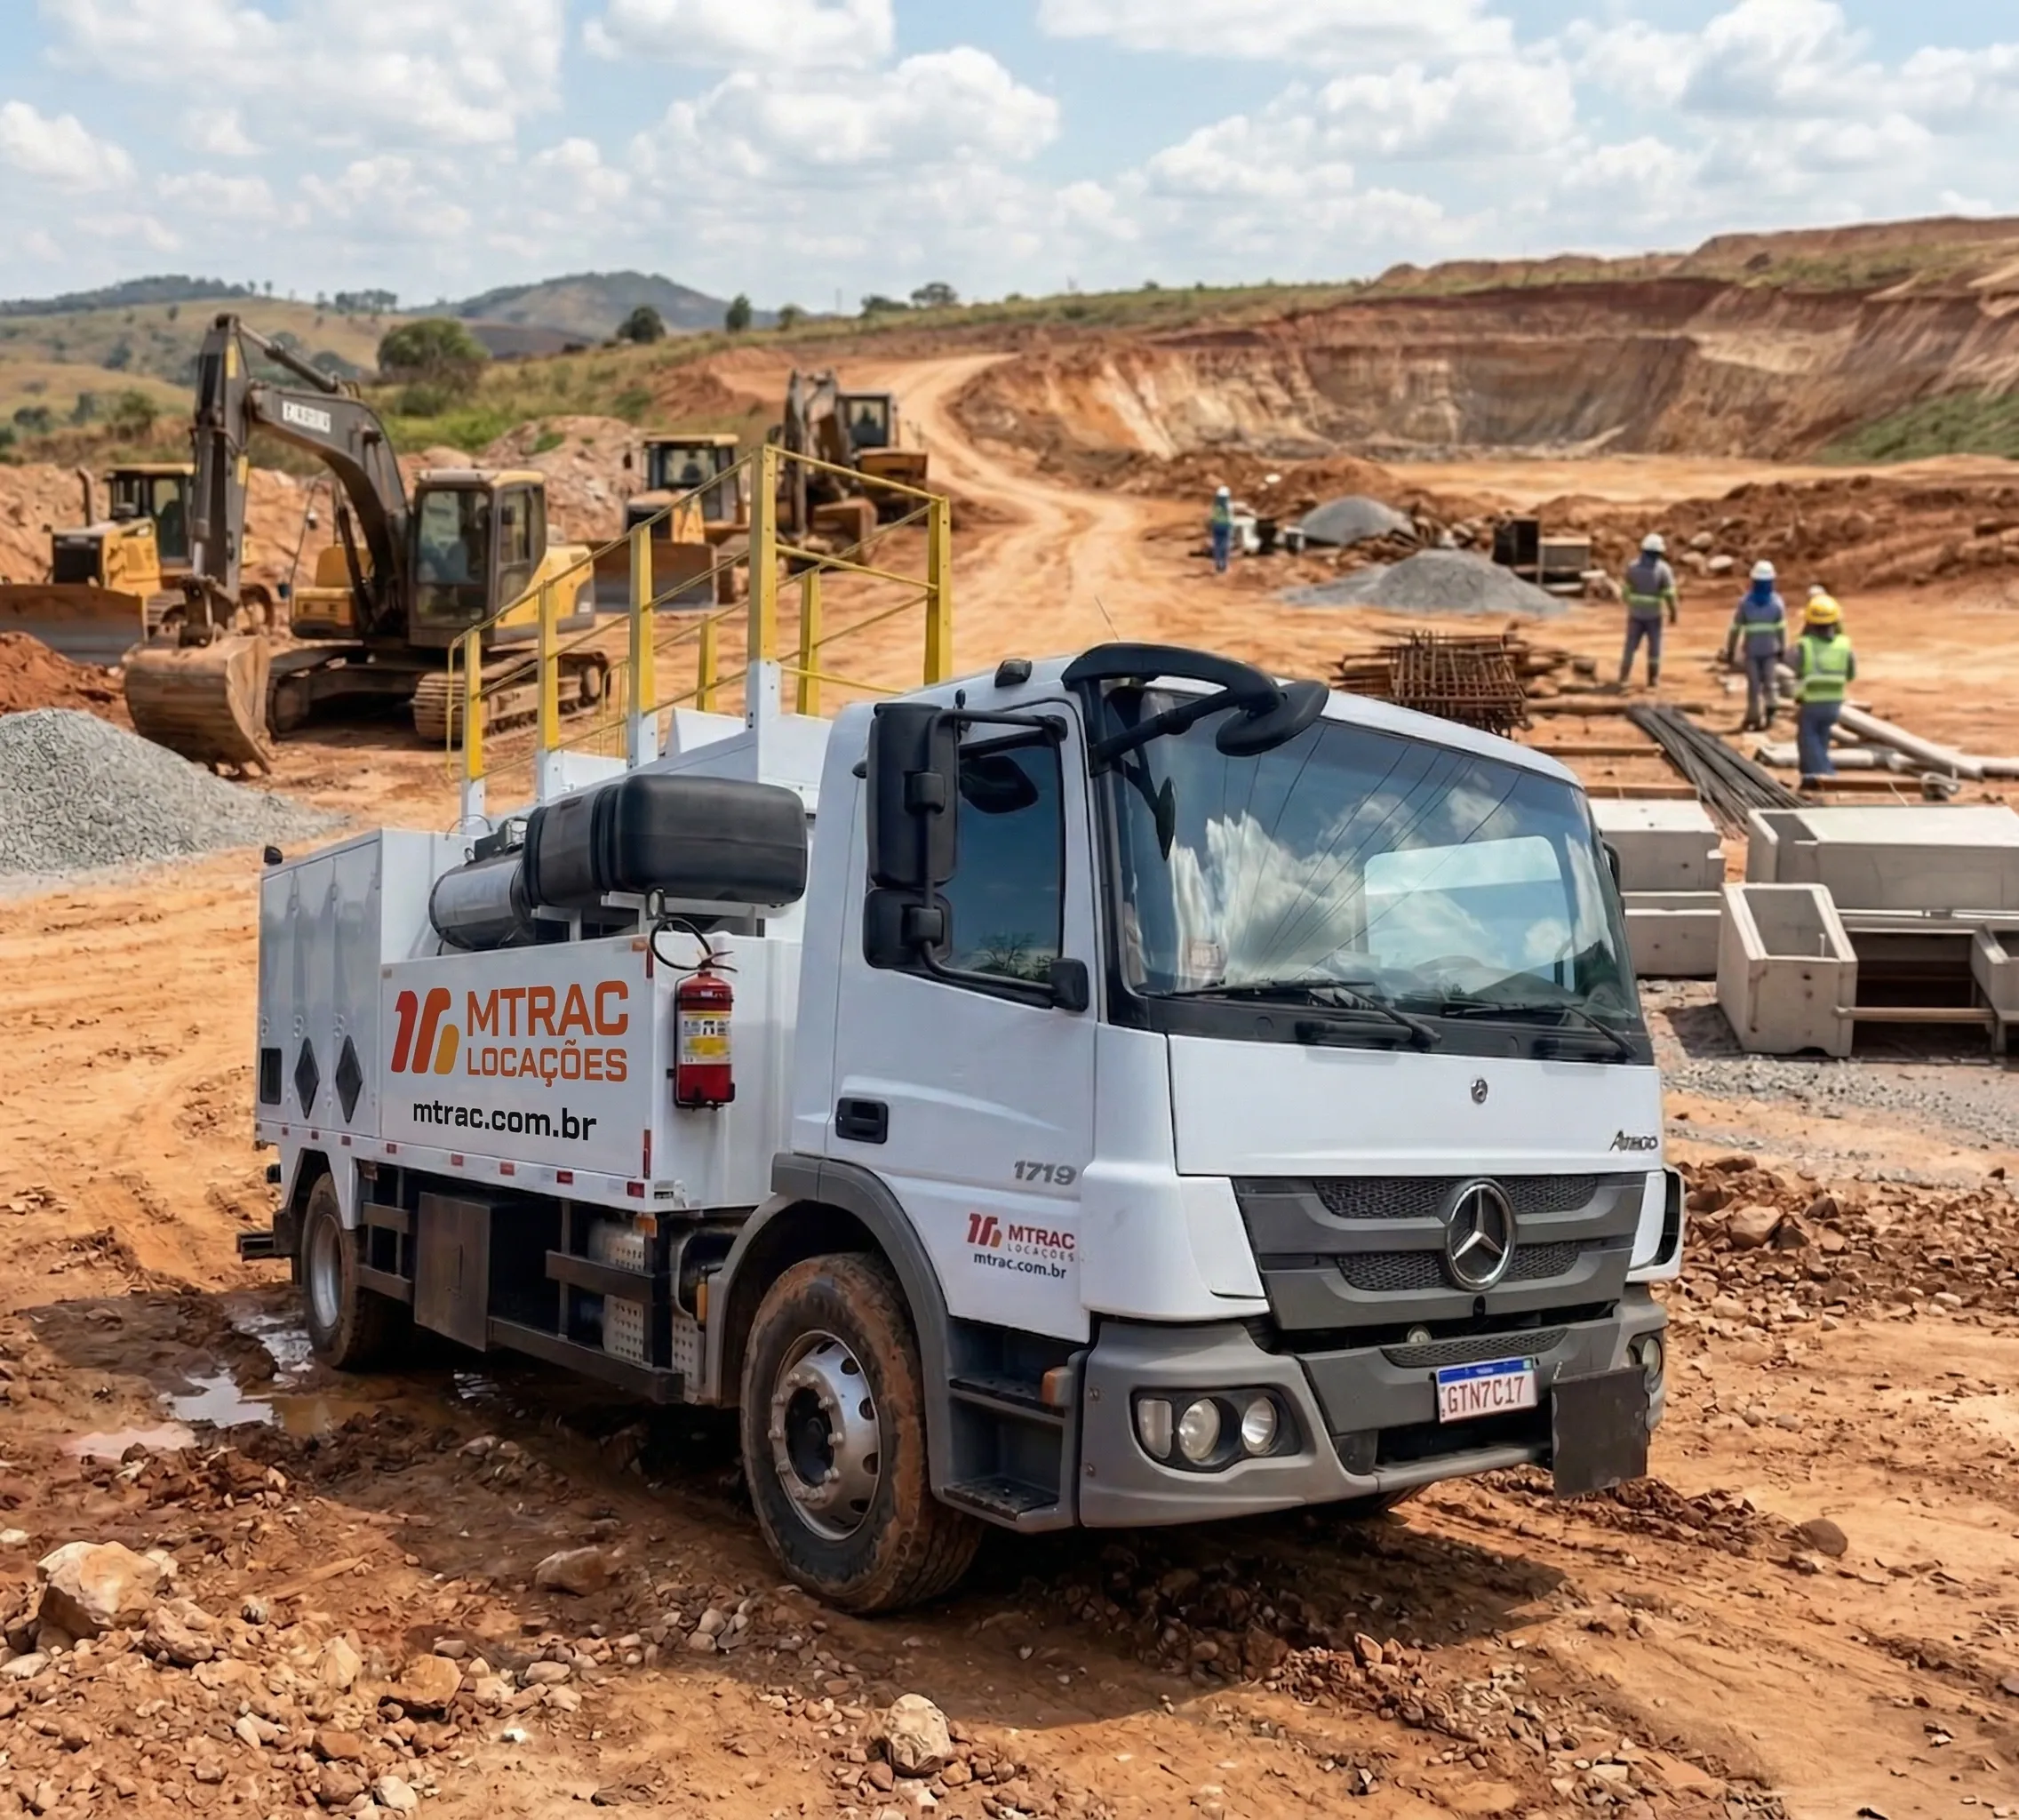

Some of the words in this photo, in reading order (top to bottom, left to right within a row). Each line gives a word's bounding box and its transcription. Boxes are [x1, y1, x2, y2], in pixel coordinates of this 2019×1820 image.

[467, 980, 628, 1037] MTRAC
[467, 1040, 627, 1087] LOCAÇÕES
[413, 1100, 597, 1141] mtrac.com.br
[1014, 1161, 1077, 1185] 1719
[1007, 1243, 1074, 1262] LOCAÇÕES
[1008, 1224, 1074, 1249] MTRAC
[973, 1253, 1067, 1279] mtrac.com.br
[1448, 1376, 1524, 1414] GTN7C17
